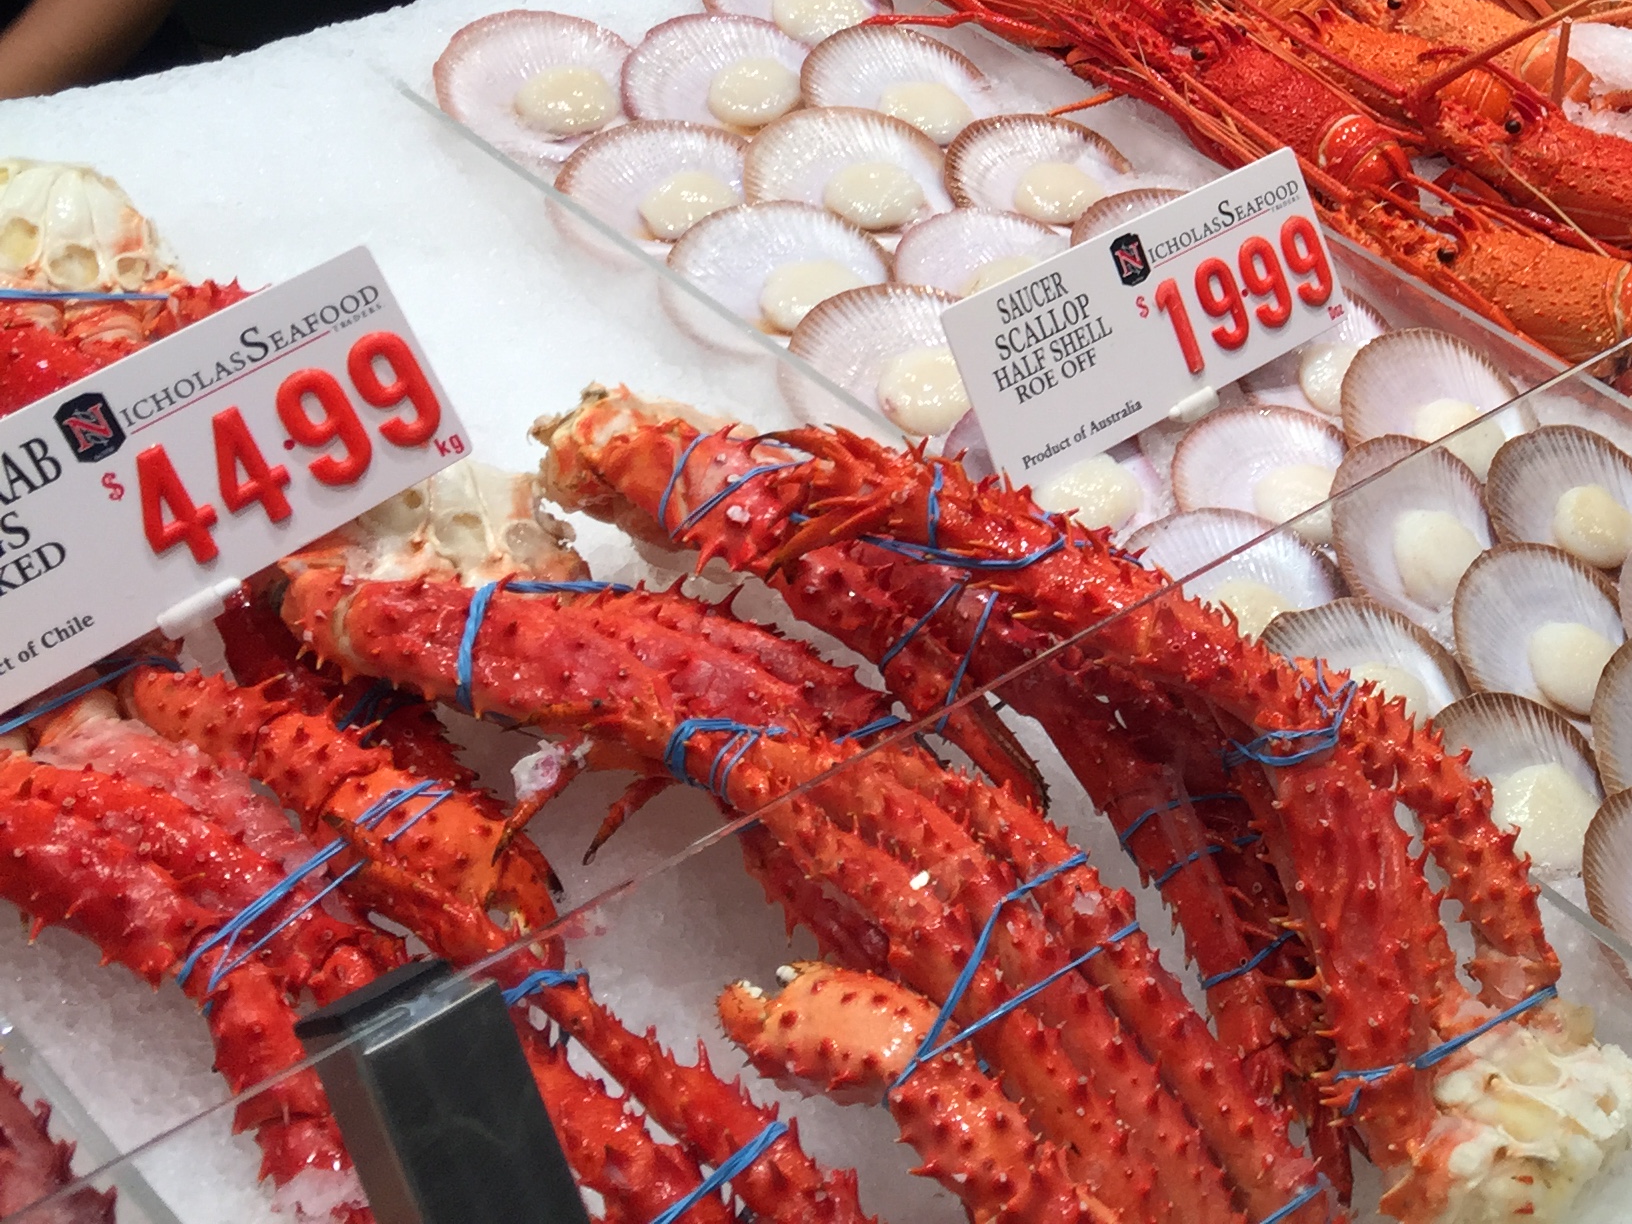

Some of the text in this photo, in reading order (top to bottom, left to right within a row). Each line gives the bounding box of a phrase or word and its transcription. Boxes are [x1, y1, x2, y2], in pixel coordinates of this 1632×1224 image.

[994, 293, 1092, 362] SCALLOP
[996, 271, 1069, 326] SAUCER
[992, 316, 1113, 393] HALF SHELL
[1014, 347, 1099, 405] ROE OFF
[434, 434, 465, 457] kg
[1022, 398, 1144, 471] Product of Australia
[0, 438, 62, 506] AB
[0, 510, 30, 558] S
[17, 641, 39, 663] of
[40, 614, 95, 650] Chile
